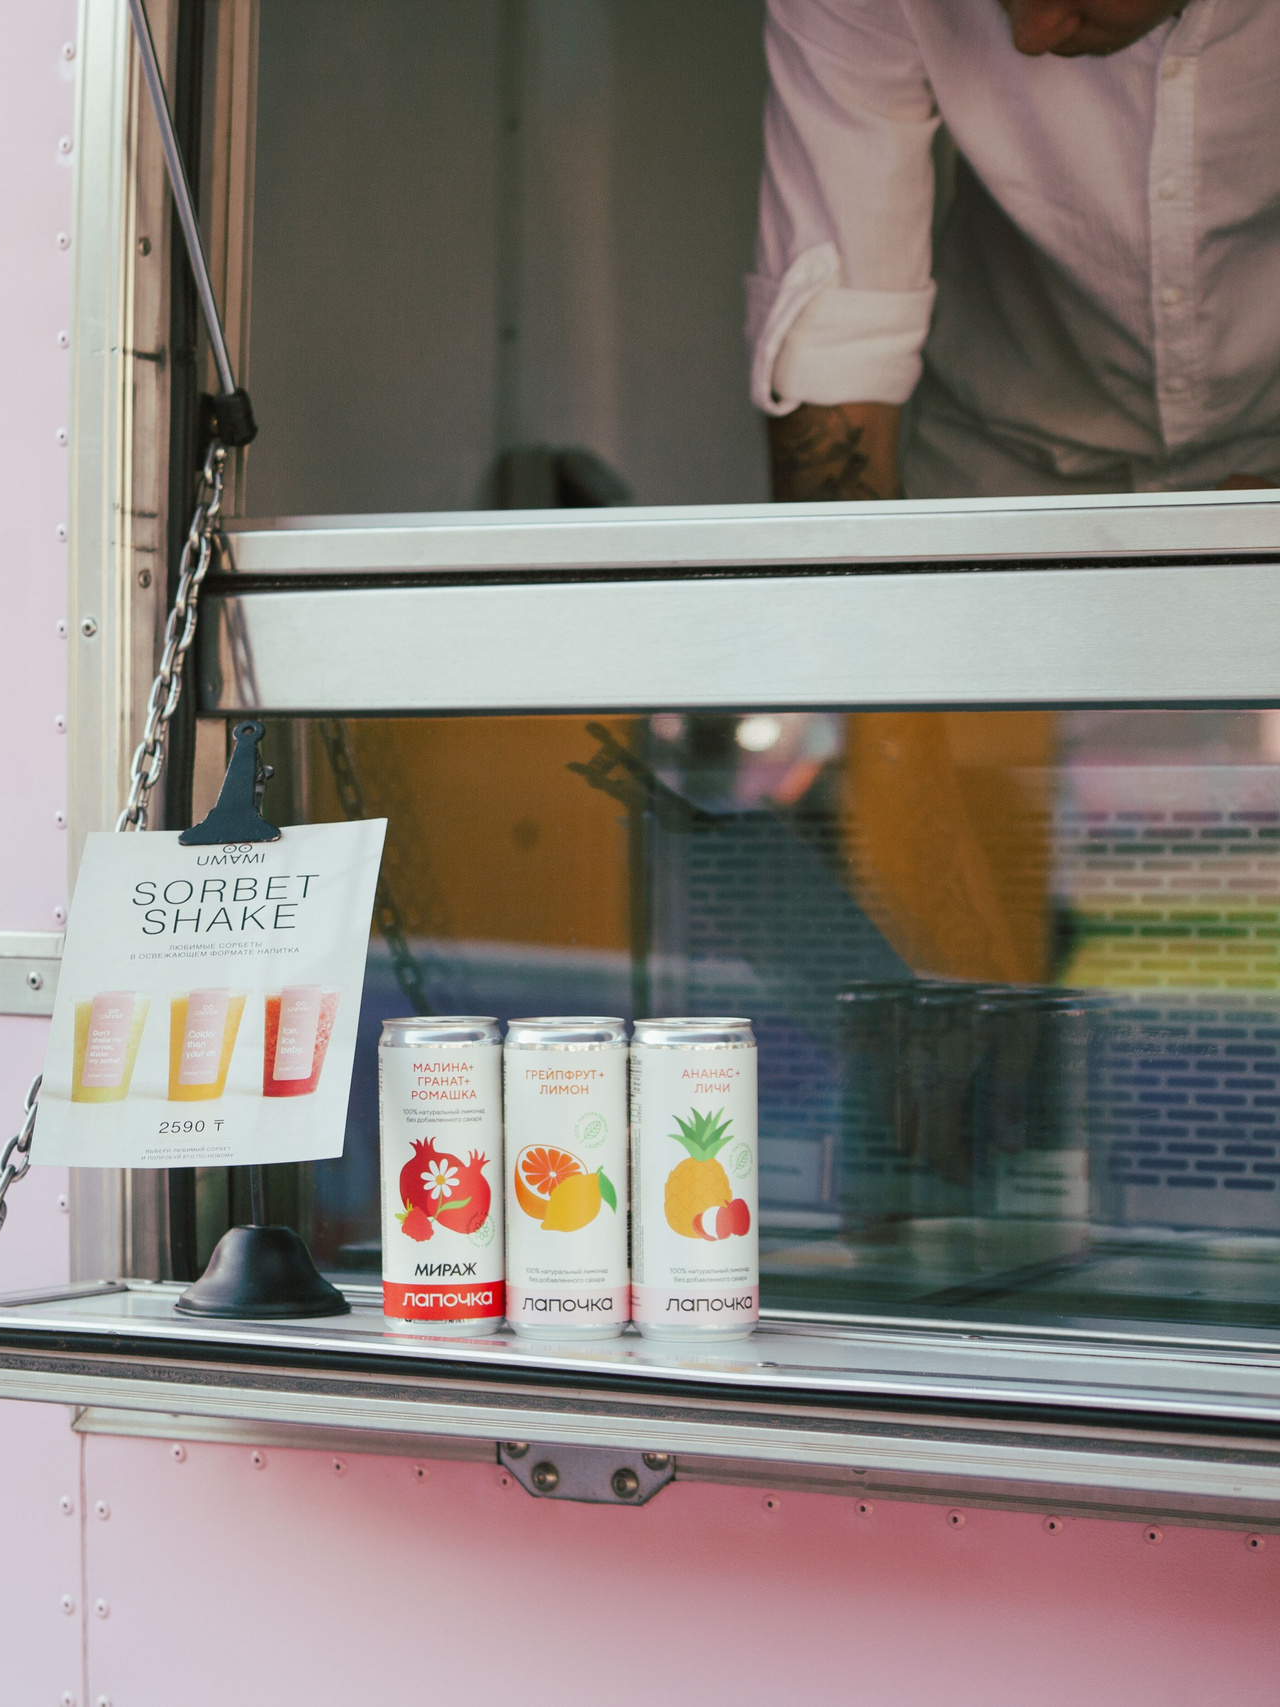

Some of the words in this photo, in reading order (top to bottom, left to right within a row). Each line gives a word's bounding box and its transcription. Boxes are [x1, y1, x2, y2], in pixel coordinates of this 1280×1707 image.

[132, 874, 320, 906] SORBET
[142, 903, 299, 935] SHAKE
[169, 943, 216, 951] ЛЮБИМЫЕ
[218, 941, 263, 949] СОРБЕТЫ
[138, 951, 207, 960] ОСВЕЖАЮЩЕМ
[210, 948, 255, 957] ФОРМАТЕ
[257, 947, 300, 955] НАПИТКА
[188, 1030, 216, 1039] Colder
[187, 1040, 206, 1048] than
[185, 1051, 205, 1060] your
[413, 1062, 474, 1073] МАЛИНА+
[417, 1076, 470, 1087] ГРАНАТ+
[539, 1084, 589, 1095] ЛИМОН
[694, 1083, 731, 1094] ЛИЧИ
[411, 1090, 477, 1101] РОМАШКА
[418, 1108, 461, 1117] натуральный
[416, 1116, 462, 1124] добавленного
[158, 1120, 206, 1134] 2590
[414, 1262, 477, 1277] МИРАЖ
[540, 1267, 582, 1276] натуральный
[688, 1267, 729, 1276] натуральный
[539, 1276, 584, 1284] добавленного
[685, 1276, 731, 1284] добавленного
[402, 1291, 492, 1308] лапочка
[522, 1297, 613, 1312] лапочка
[665, 1296, 753, 1312] лапочка
